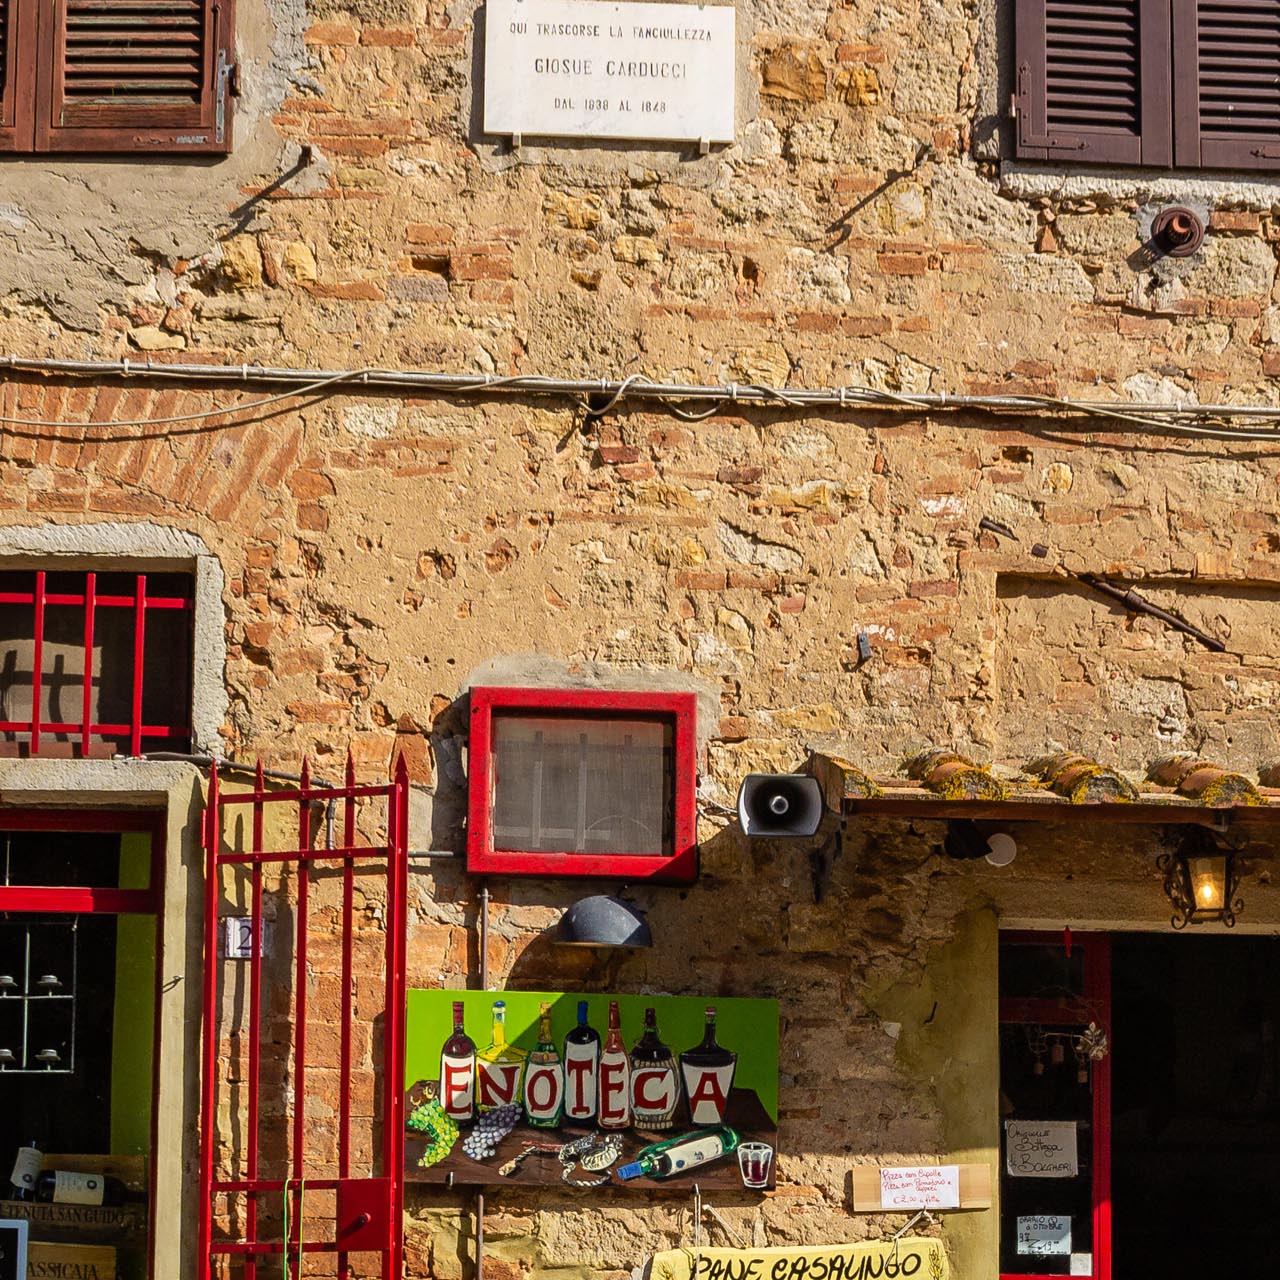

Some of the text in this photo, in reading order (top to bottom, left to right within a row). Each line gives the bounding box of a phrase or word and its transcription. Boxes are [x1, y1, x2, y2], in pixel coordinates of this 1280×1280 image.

[509, 23, 712, 41] QUI TRASCORSE LA FANCIULLEZZA
[534, 58, 687, 79] GIOSUE CARDUCCI
[554, 98, 575, 110] DAL
[584, 99, 609, 111] 1838
[618, 101, 632, 112] AL
[444, 1058, 728, 1122] ENOTECA
[8, 1205, 124, 1225] TENUTA SAN GUIDO
[28, 1261, 98, 1280] ASSICAIA
